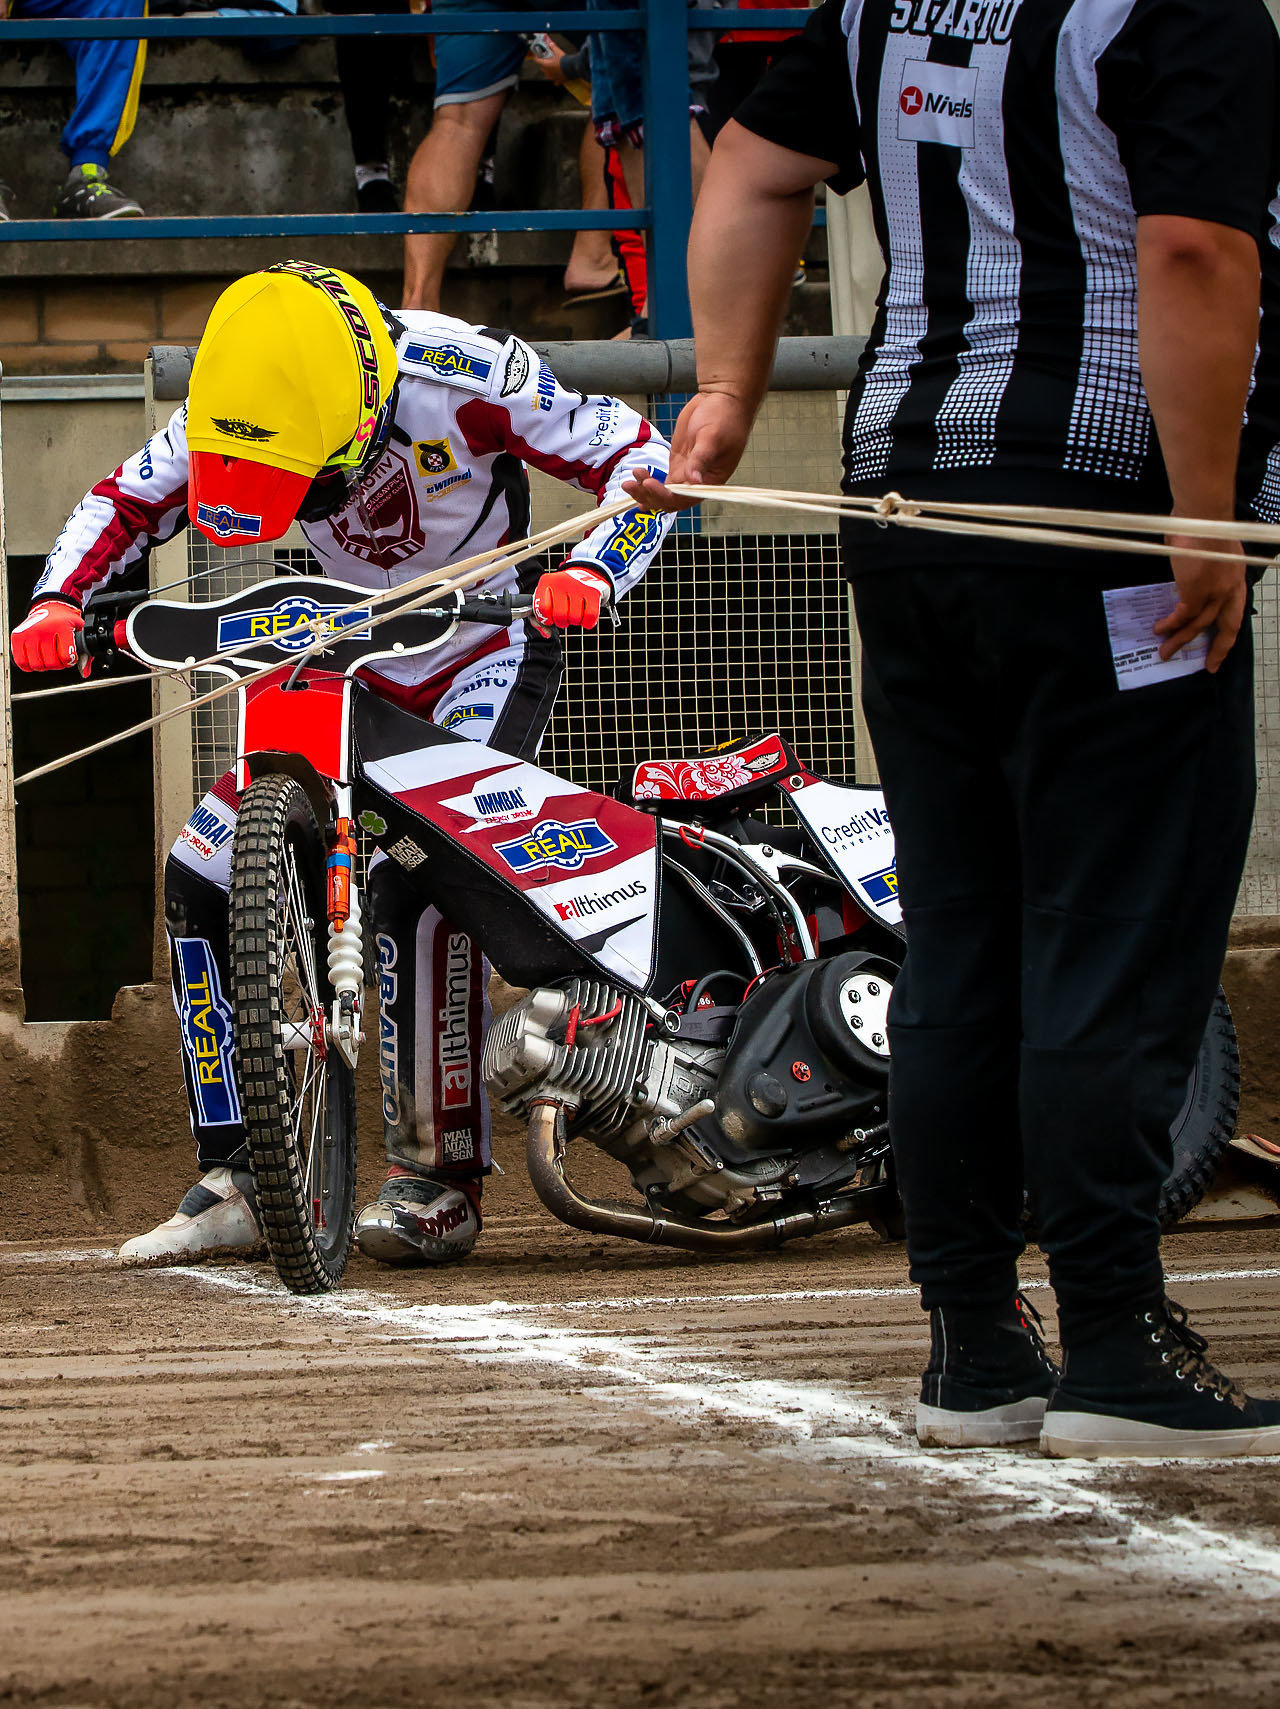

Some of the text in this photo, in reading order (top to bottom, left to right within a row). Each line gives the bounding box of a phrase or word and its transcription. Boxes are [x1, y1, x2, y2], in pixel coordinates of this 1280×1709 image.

[421, 350, 474, 374] REALL
[205, 510, 244, 530] REALL
[521, 829, 592, 861] REALL
[188, 971, 223, 1084] REALL
